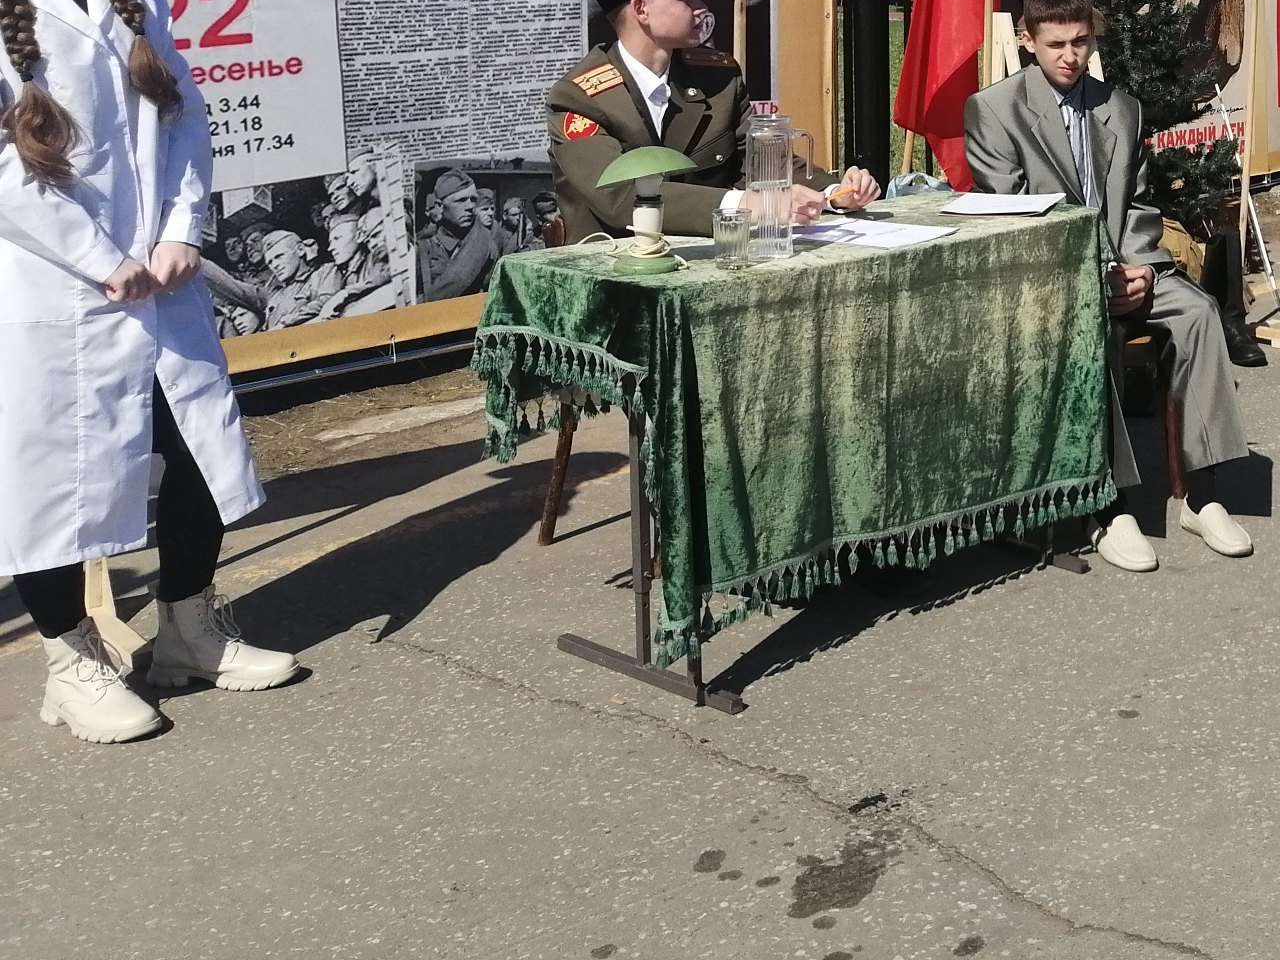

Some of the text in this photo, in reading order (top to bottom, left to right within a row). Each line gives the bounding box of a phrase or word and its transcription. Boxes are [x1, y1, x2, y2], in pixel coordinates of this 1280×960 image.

[191, 56, 303, 85] есенье
[219, 95, 261, 113] 3.44
[209, 116, 263, 136] 21.18
[1157, 122, 1217, 149] КАЖДЫЙ
[1221, 121, 1247, 139] ДЕН
[212, 133, 294, 158] ня 17.34
